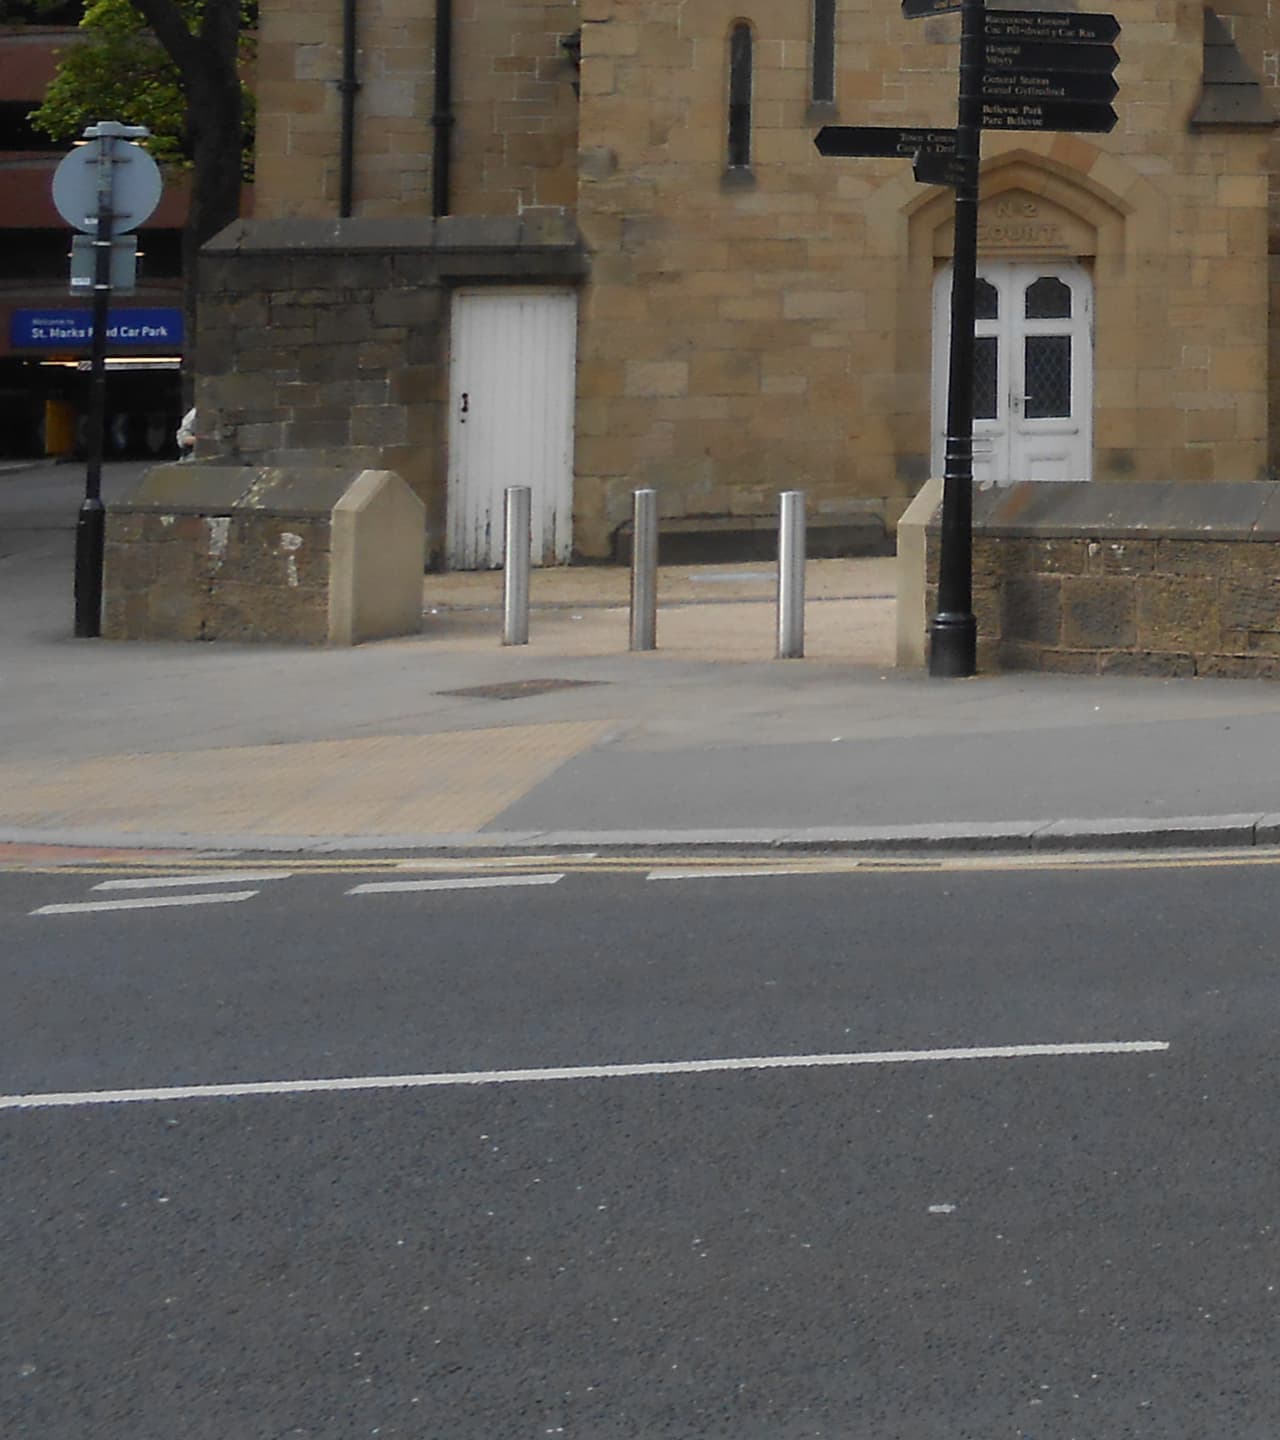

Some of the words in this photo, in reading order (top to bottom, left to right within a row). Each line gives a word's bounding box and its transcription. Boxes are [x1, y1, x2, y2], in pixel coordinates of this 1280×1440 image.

[1023, 105, 1043, 115] Park
[120, 327, 140, 337] Car
[142, 326, 168, 336] Park
